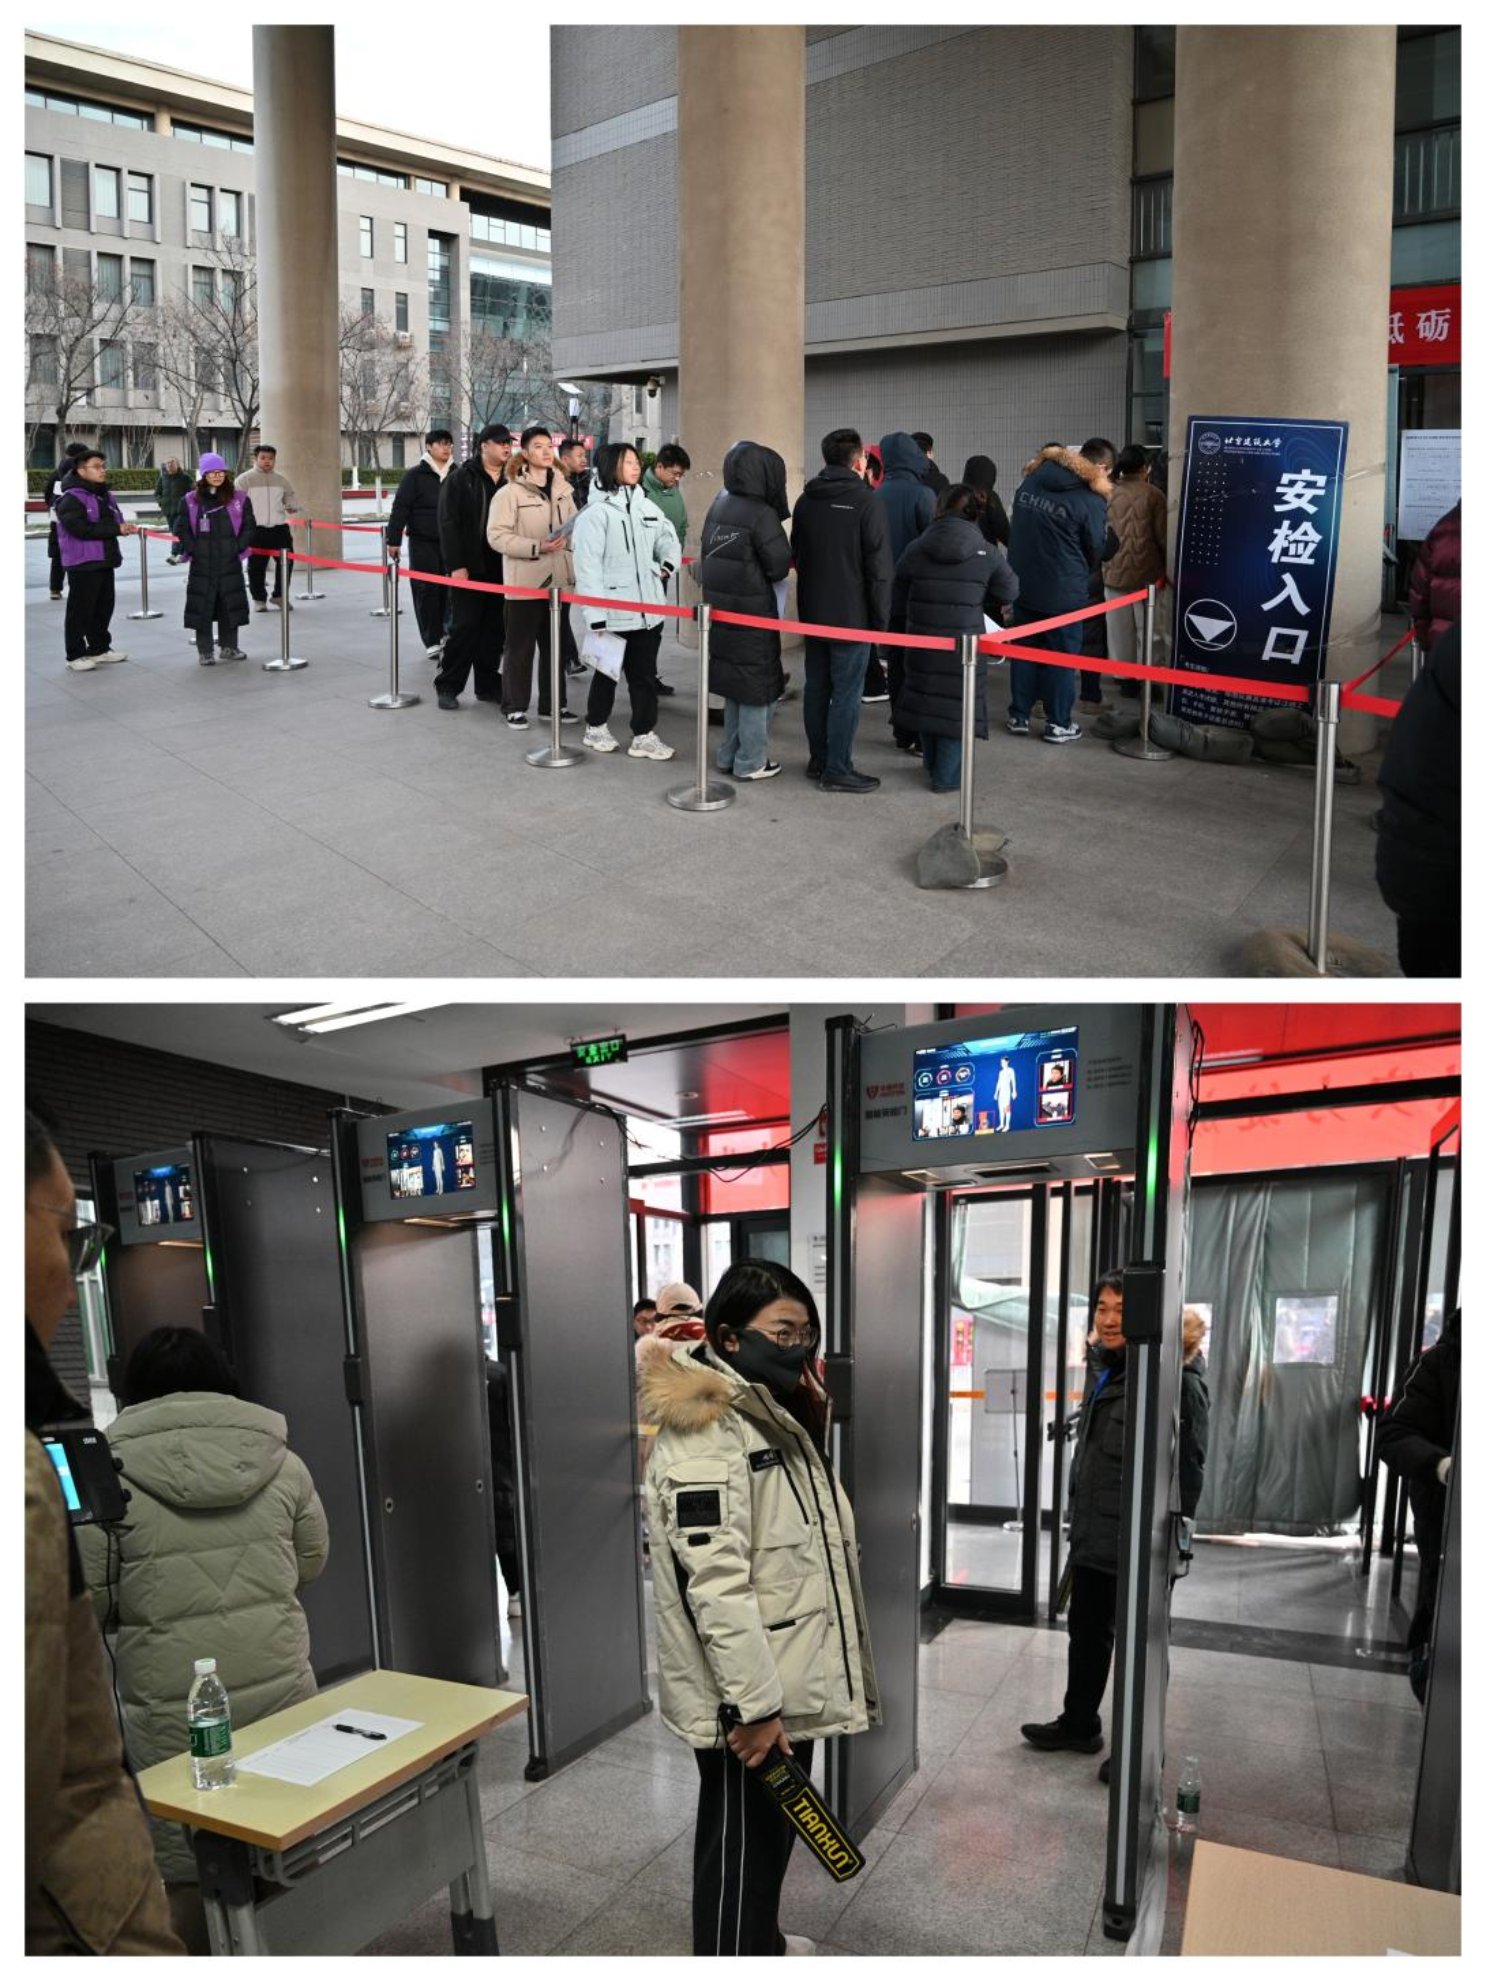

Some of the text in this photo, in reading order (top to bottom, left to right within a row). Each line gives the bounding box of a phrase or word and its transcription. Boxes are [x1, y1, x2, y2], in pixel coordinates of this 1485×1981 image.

[1019, 491, 1067, 519] CHINA
[1260, 469, 1328, 664] 安检入口
